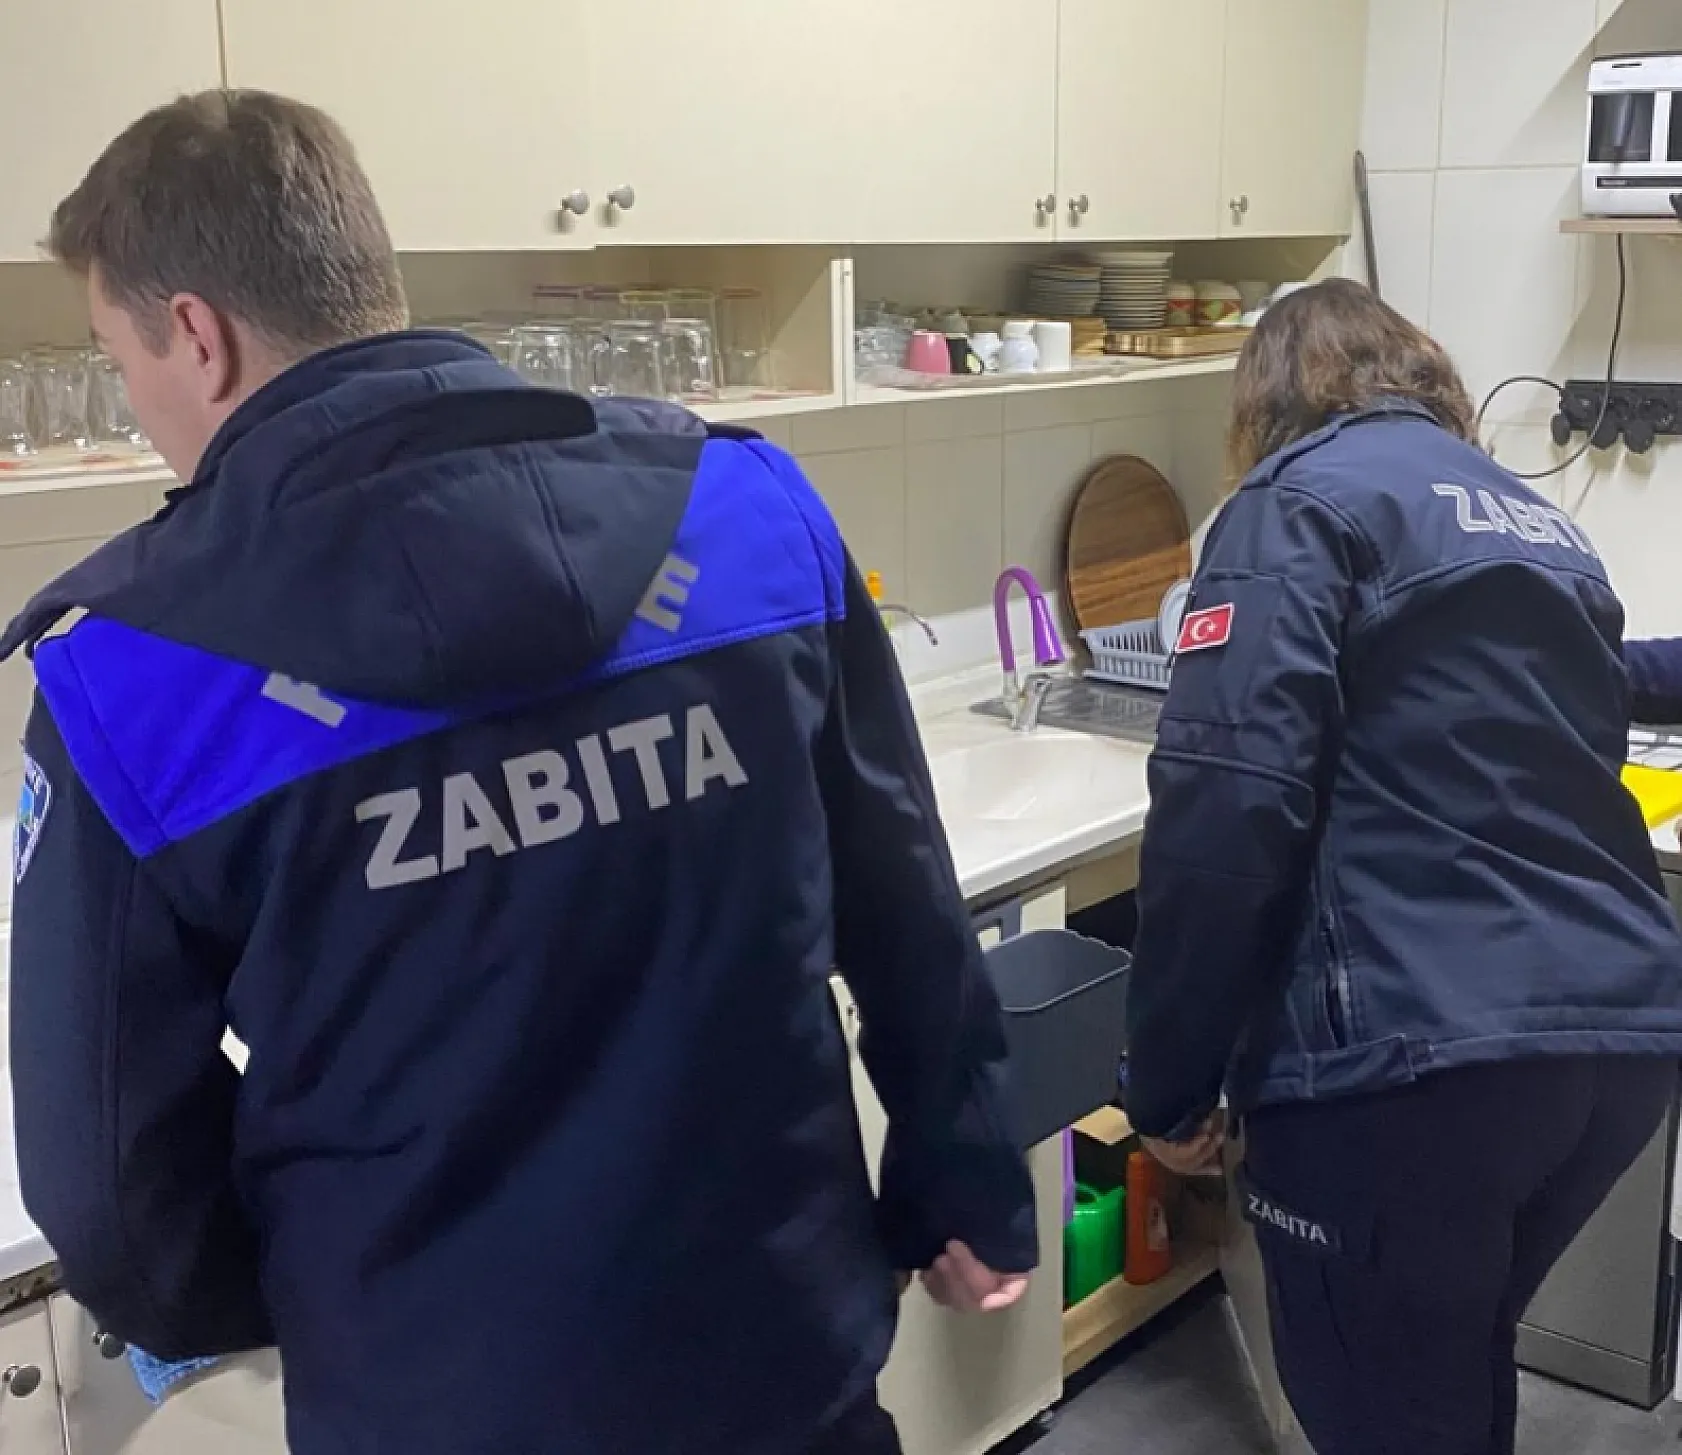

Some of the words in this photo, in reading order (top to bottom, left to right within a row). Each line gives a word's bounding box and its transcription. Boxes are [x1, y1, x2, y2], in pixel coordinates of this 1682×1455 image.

[1431, 483, 1593, 554] ZABIT
[354, 703, 750, 890] ZABITA
[1247, 1192, 1328, 1246] ZABITA
